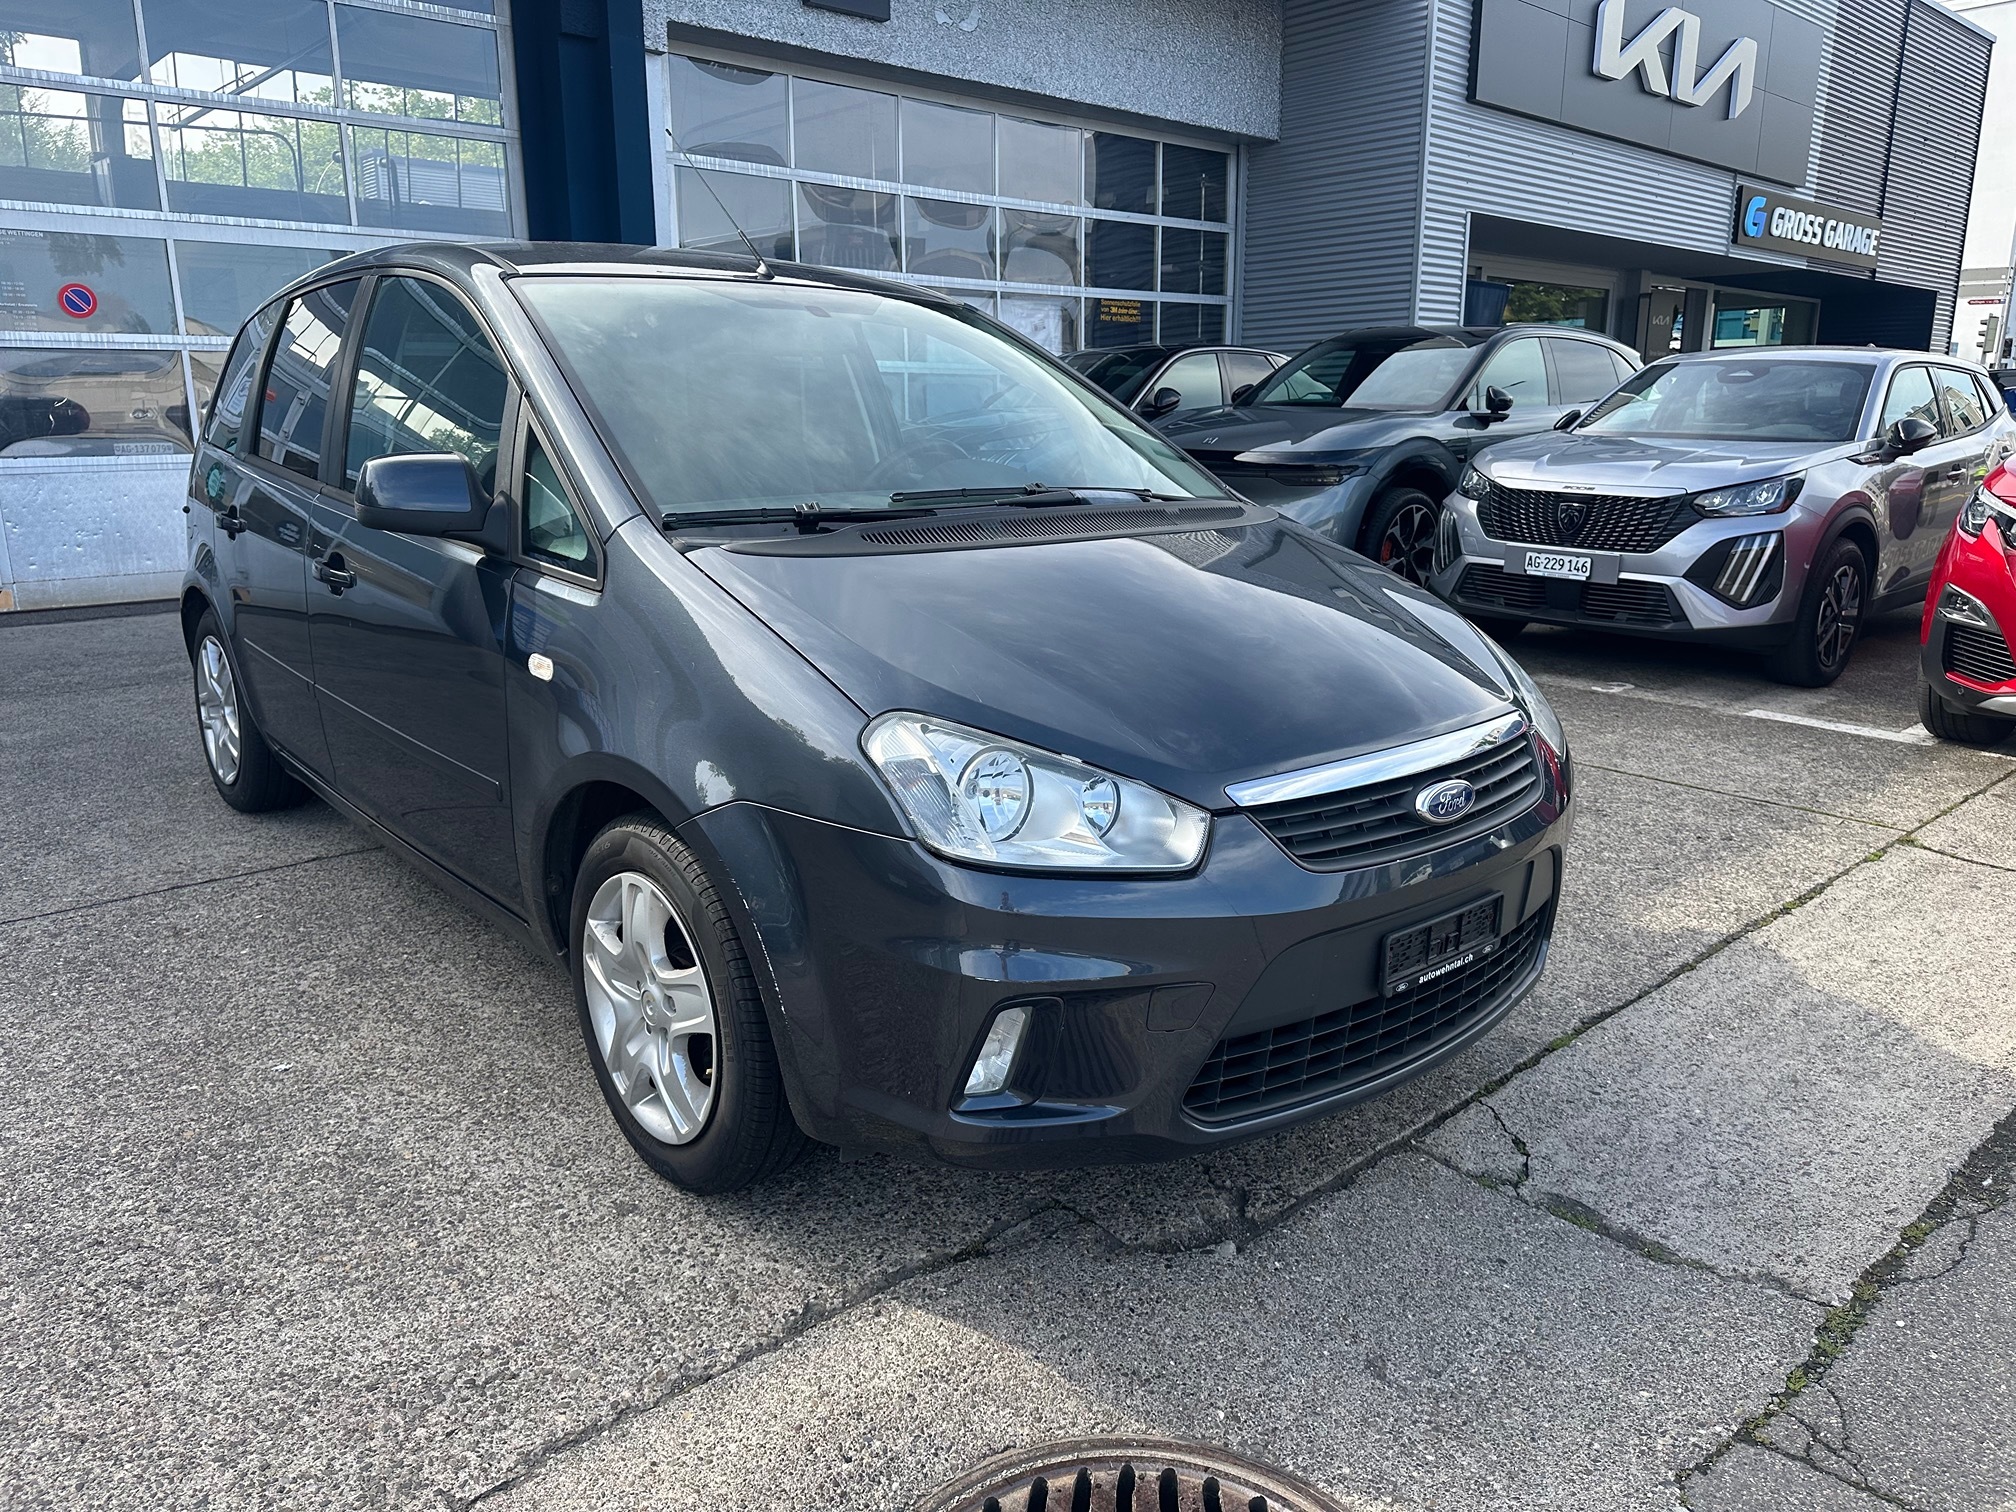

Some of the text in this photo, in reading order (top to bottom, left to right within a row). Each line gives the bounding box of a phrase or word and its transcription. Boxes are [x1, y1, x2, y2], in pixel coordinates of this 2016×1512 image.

[1770, 207, 1824, 245] GROSS
[1823, 219, 1880, 256] GARAGE
[1568, 559, 1588, 573] 146
[1439, 789, 1466, 814] Ford
[1419, 953, 1473, 984] autowehntal.ch
